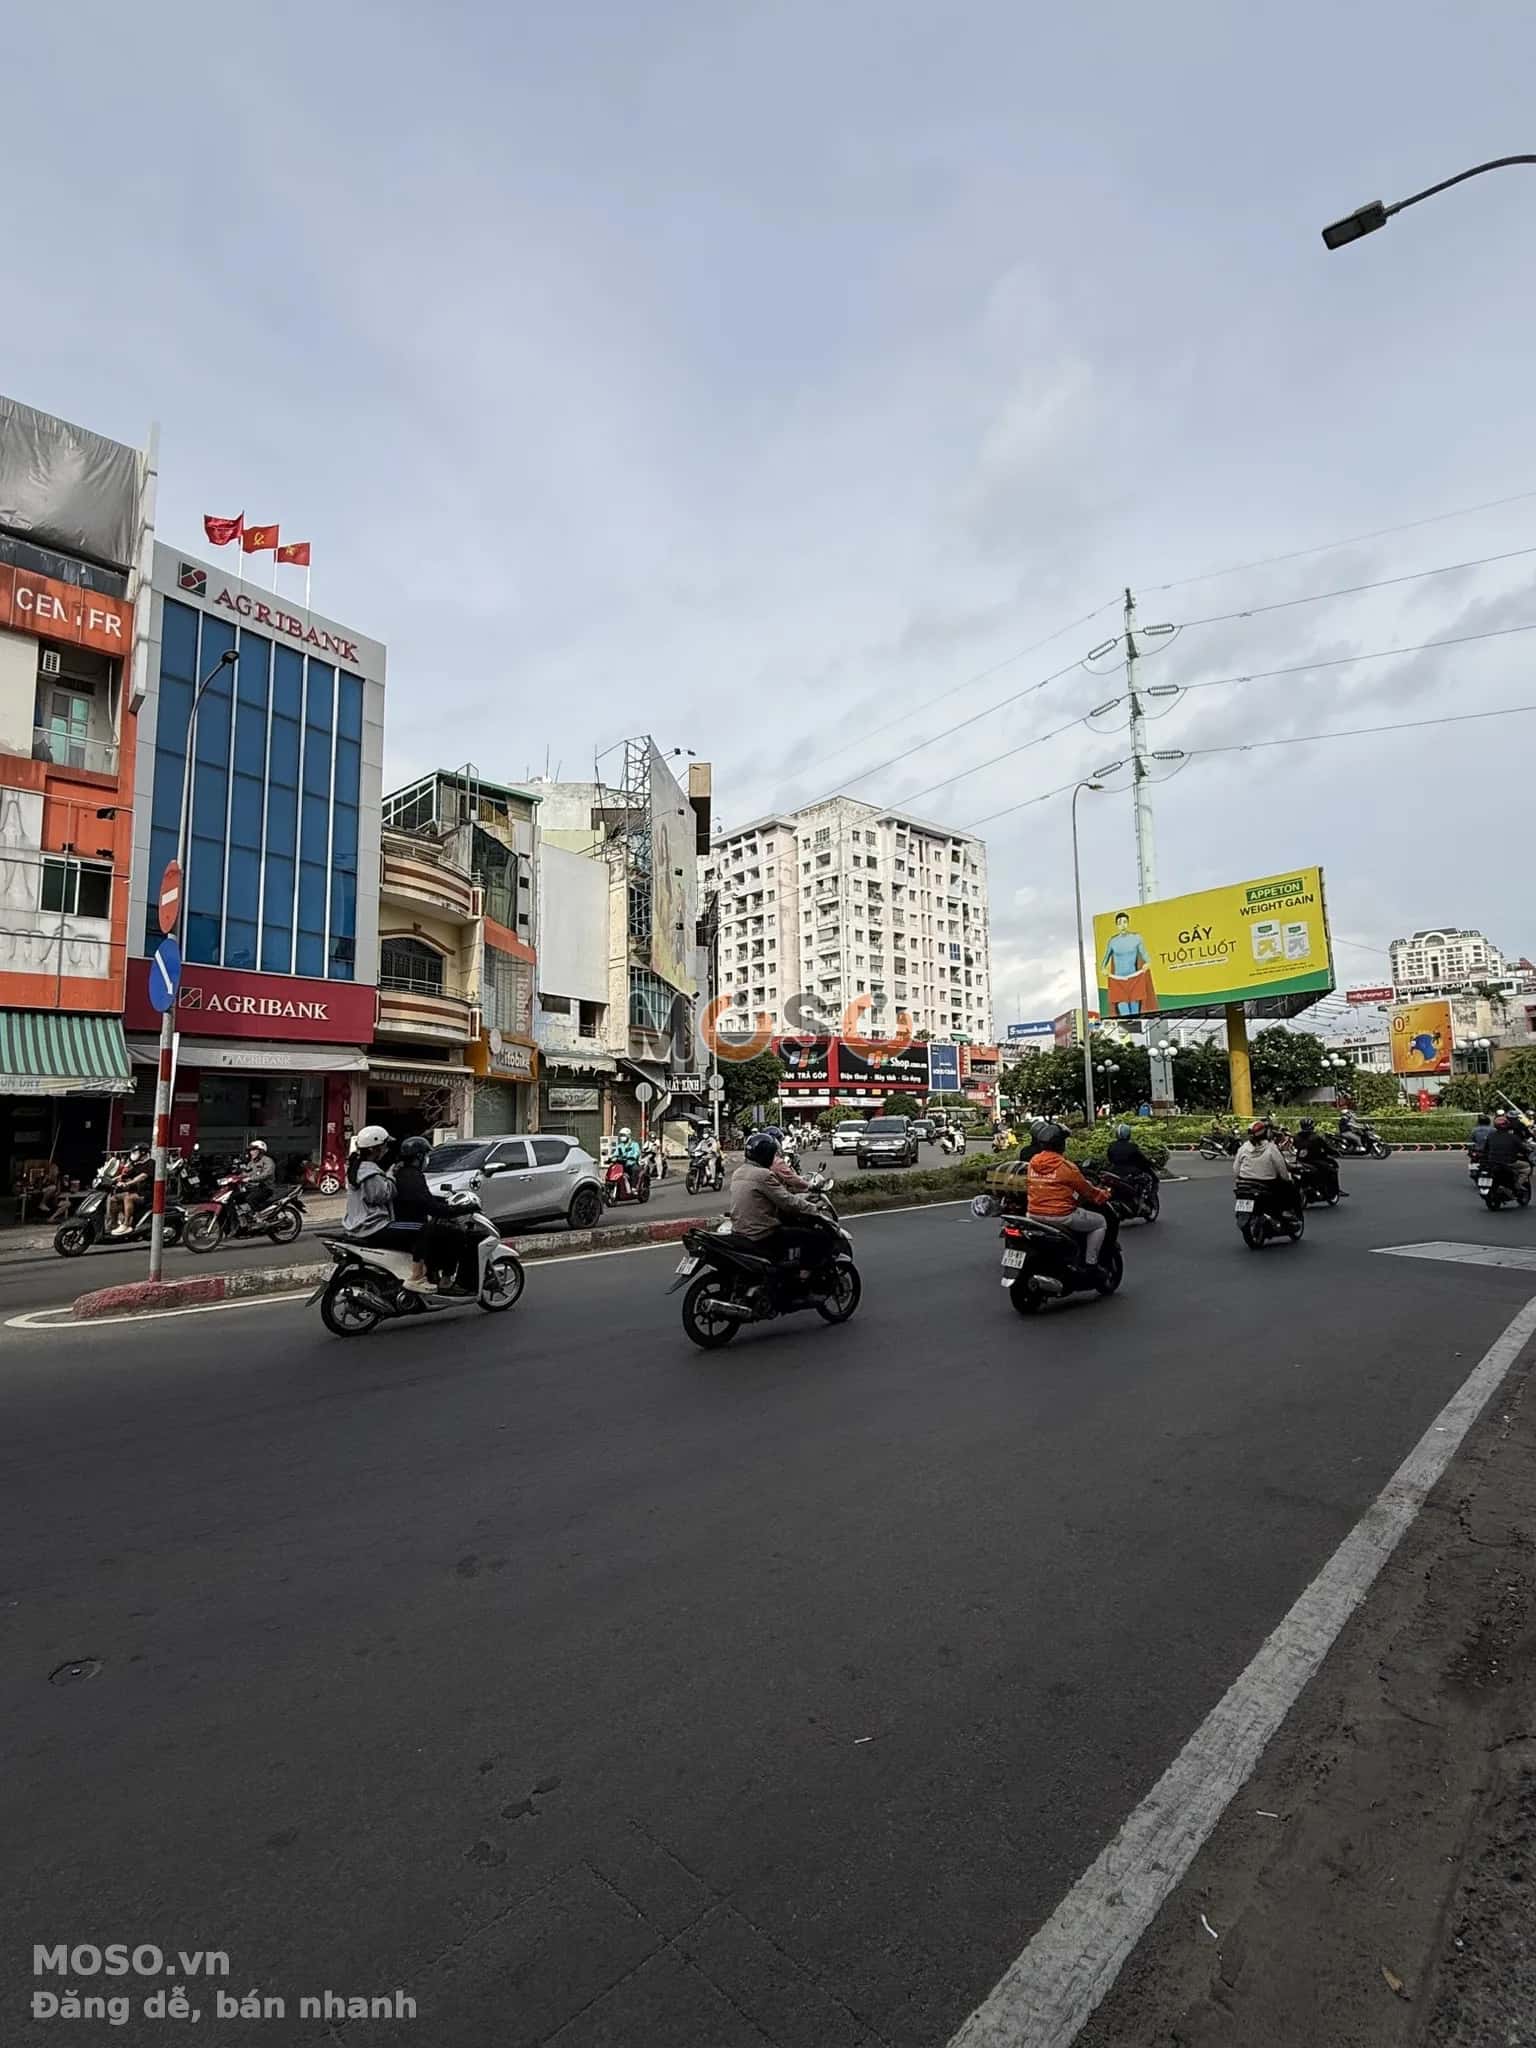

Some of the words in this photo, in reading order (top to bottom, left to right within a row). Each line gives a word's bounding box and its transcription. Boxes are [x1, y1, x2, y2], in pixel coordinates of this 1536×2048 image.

[214, 588, 360, 664] AGRIBANK
[1249, 881, 1301, 901] APPETON
[1240, 900, 1284, 917] WEIGHT
[1285, 893, 1314, 908] GAIN
[206, 994, 330, 1021] AGRIBANK
